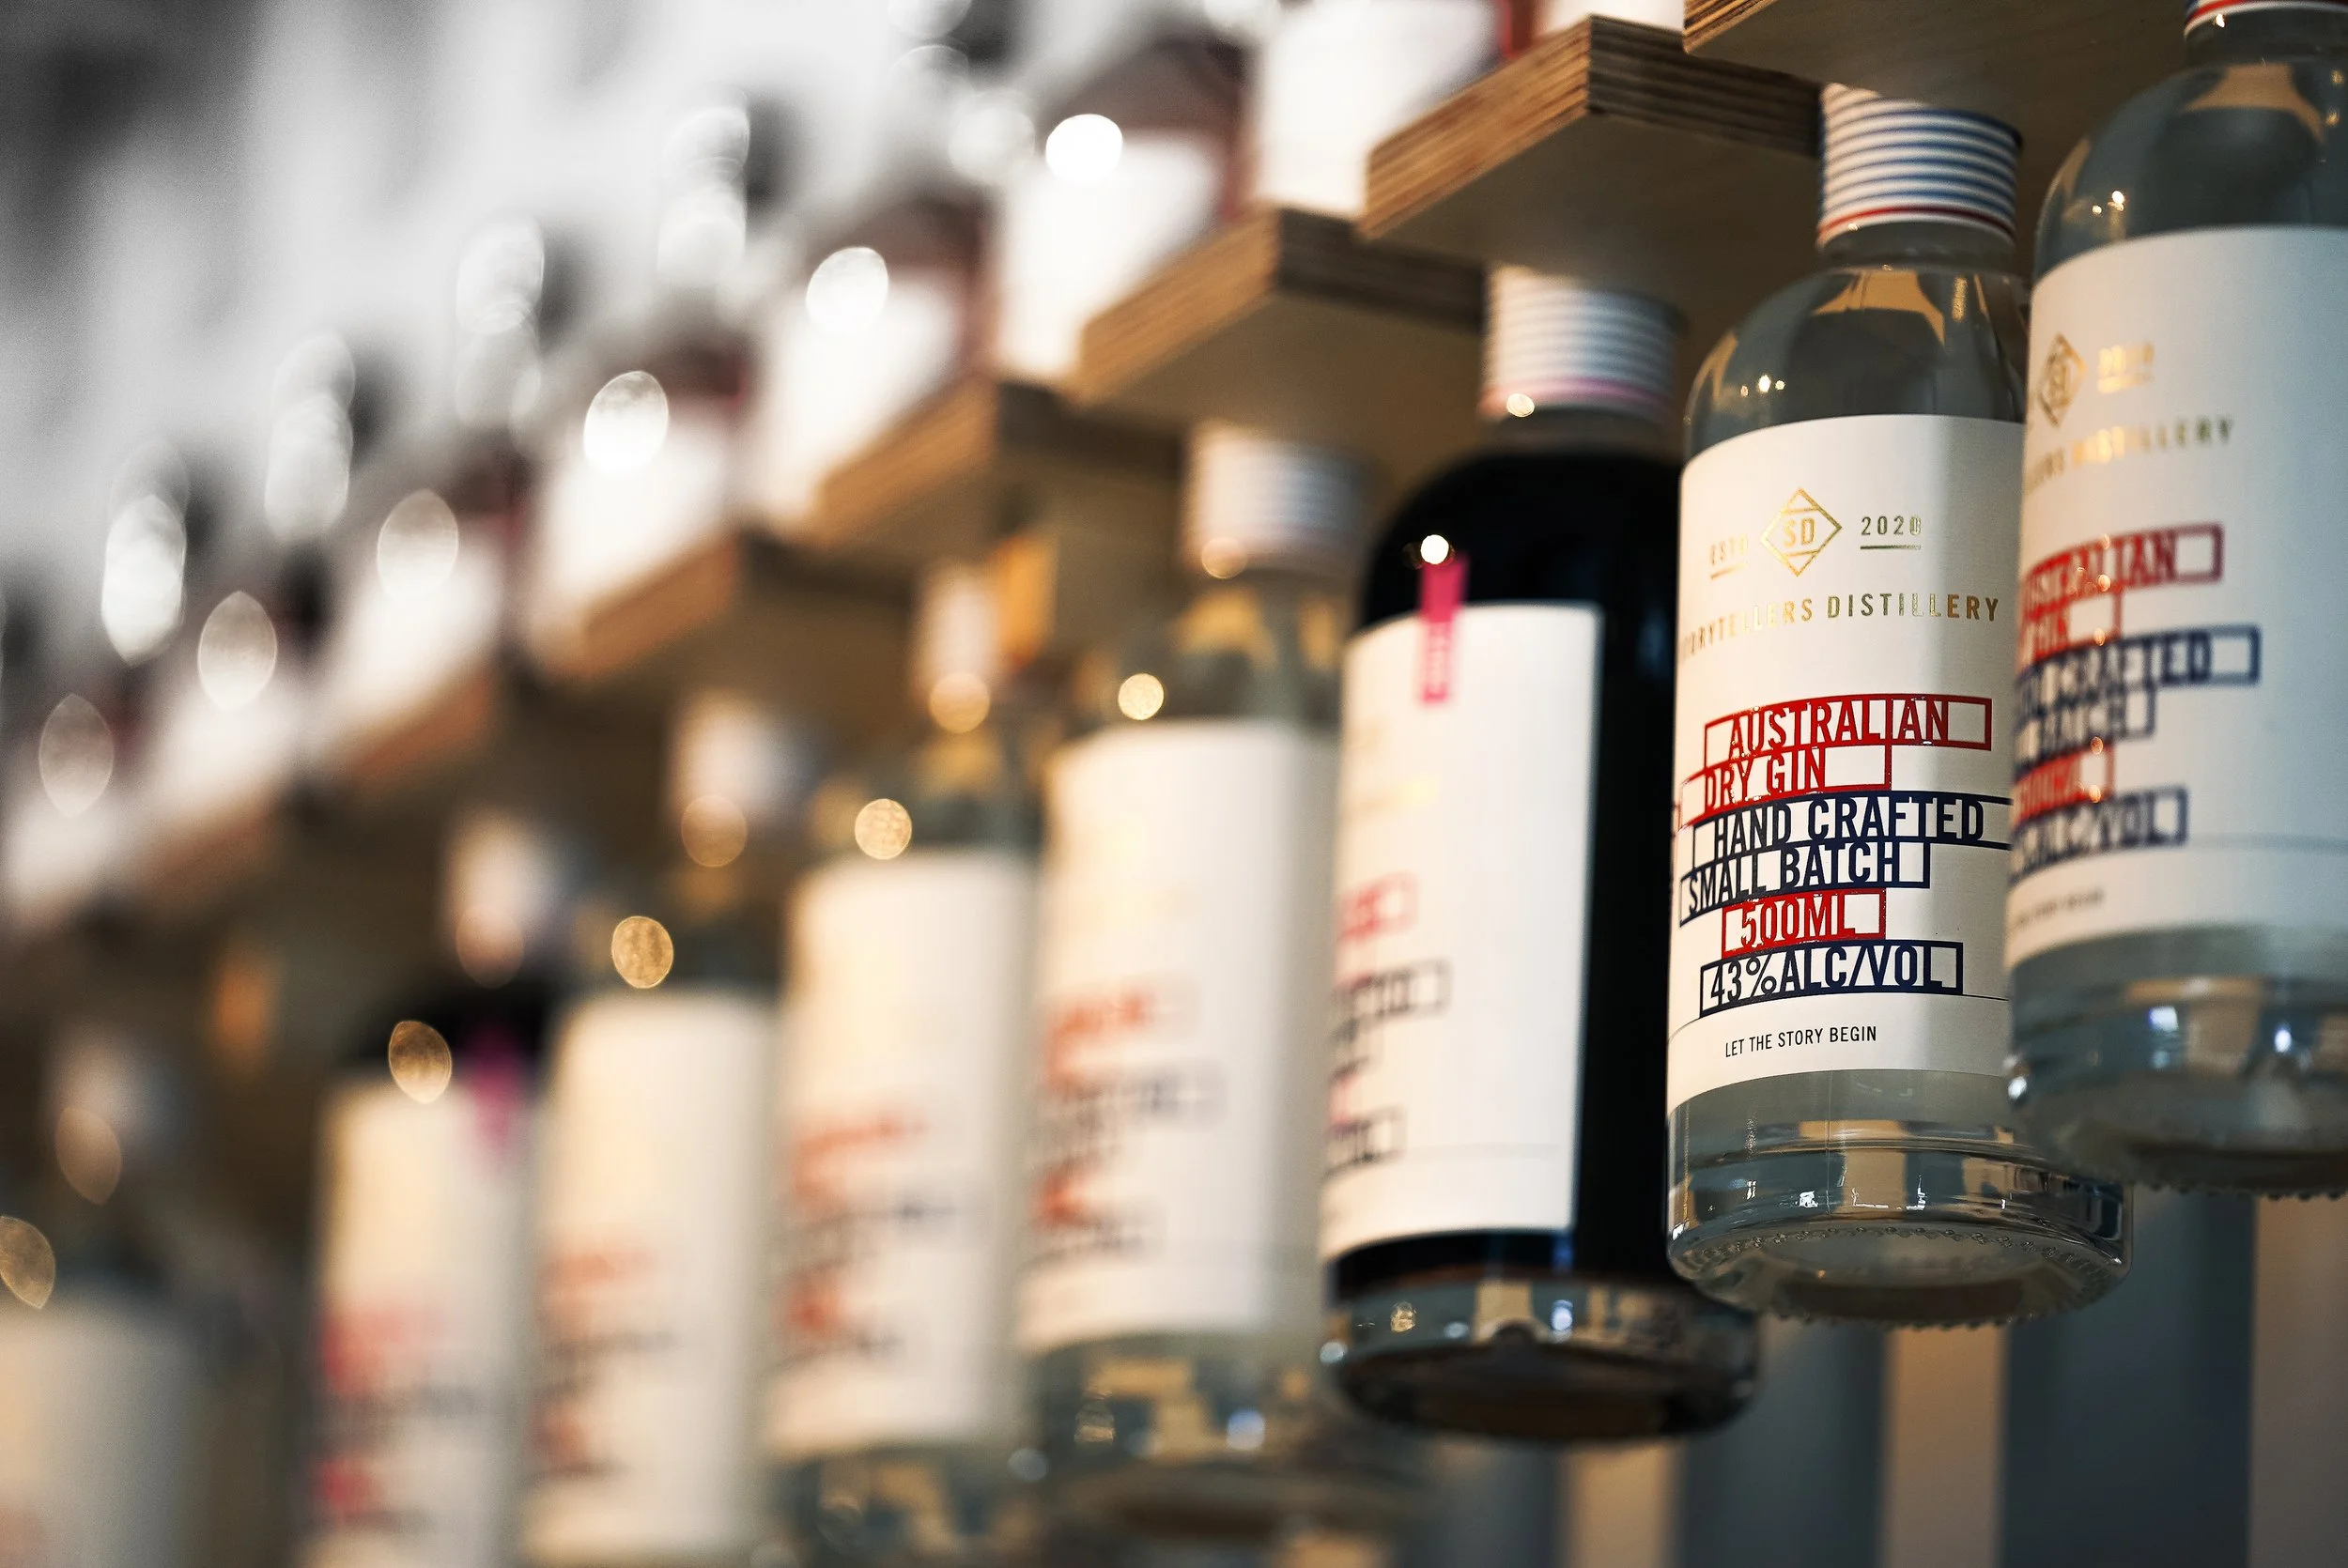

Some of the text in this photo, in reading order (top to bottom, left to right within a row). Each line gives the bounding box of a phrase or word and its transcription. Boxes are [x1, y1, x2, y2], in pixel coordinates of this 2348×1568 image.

[1783, 517, 1815, 547] SD
[1861, 515, 1922, 536] 2020
[1827, 592, 1999, 622] DISTILLERY
[1729, 696, 1949, 758] AUSTRALIAN
[1705, 748, 1825, 812] DRY GIN
[1714, 795, 1984, 859] HAND CRAFTED
[1688, 841, 1900, 911] SMALL BATCH
[1741, 893, 1856, 947] 500ML
[1709, 944, 1943, 1007] 43%ALC/VOL
[1725, 1025, 1877, 1057] LET THE STORY BEGIN
